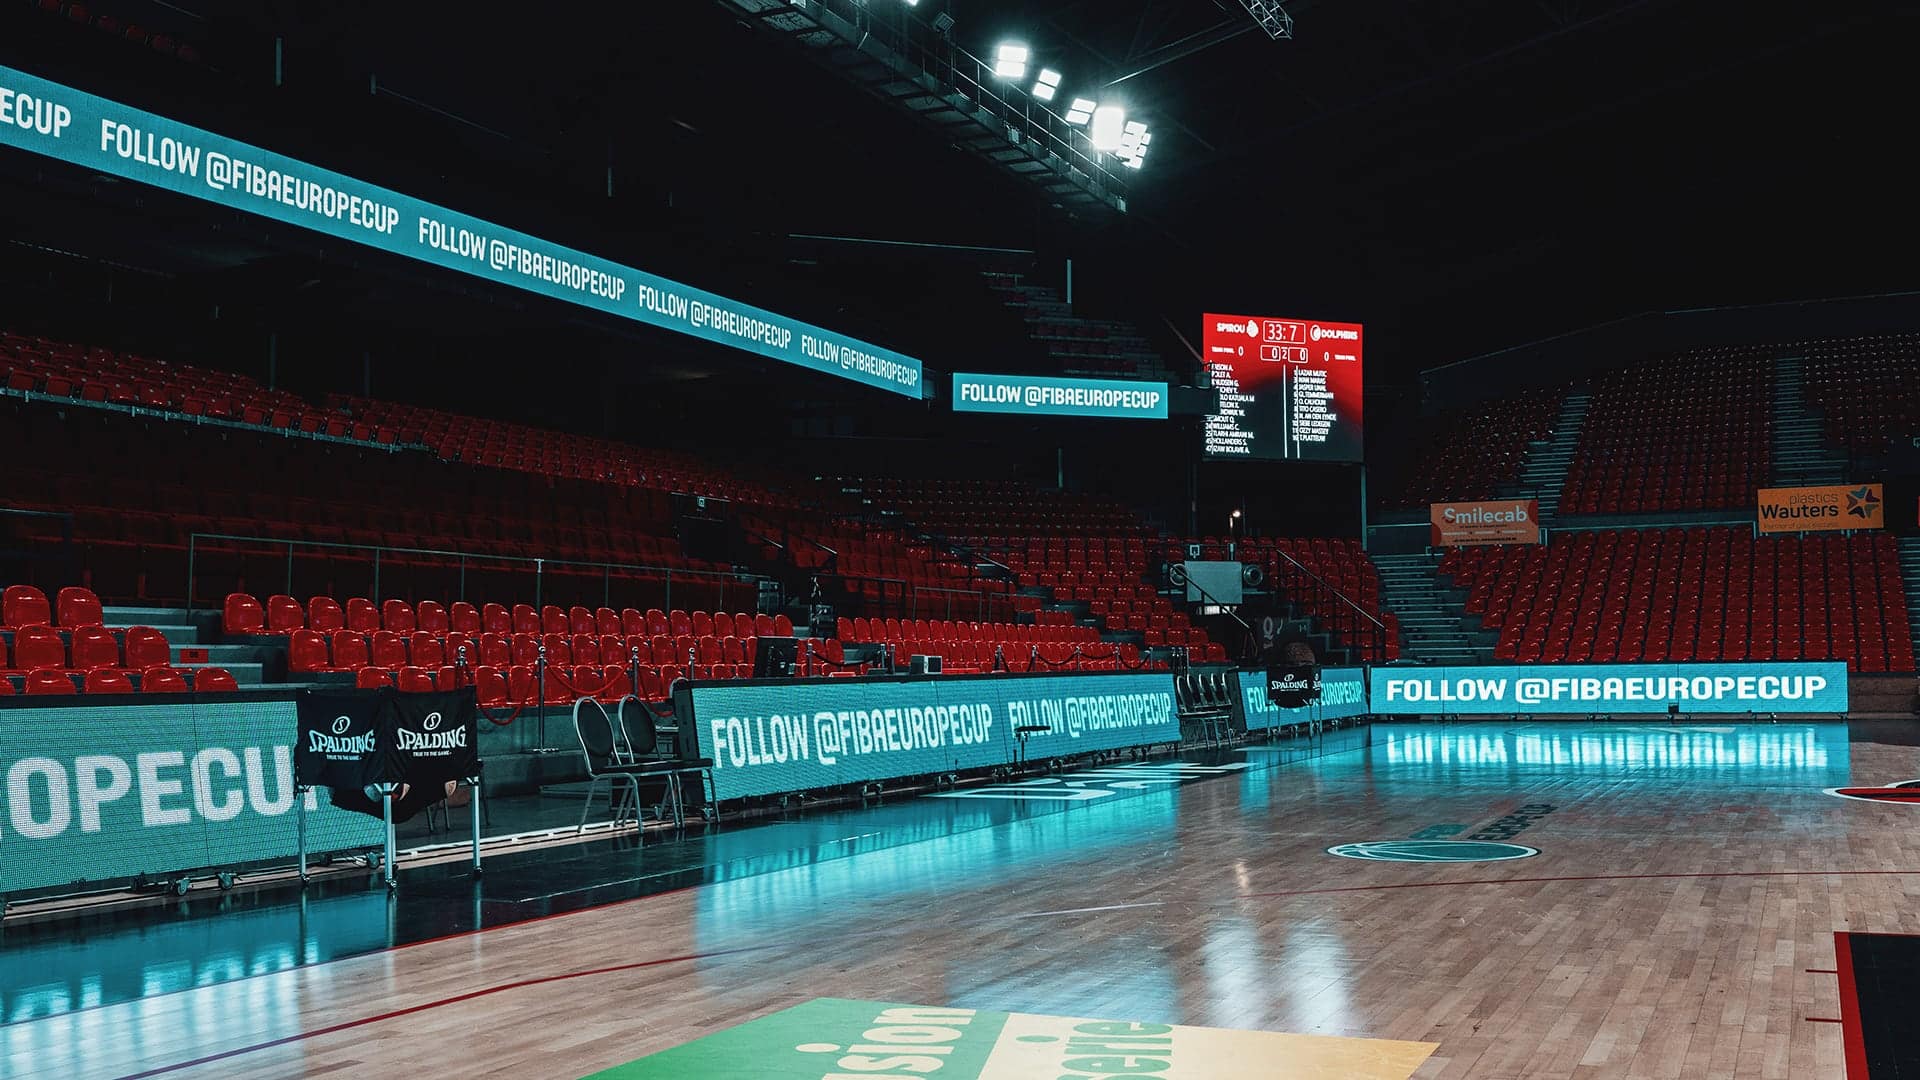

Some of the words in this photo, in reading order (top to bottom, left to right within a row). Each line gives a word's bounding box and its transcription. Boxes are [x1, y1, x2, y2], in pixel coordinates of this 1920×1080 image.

[0, 87, 71, 138] ECUP
[101, 118, 201, 177] FOLLOW
[206, 151, 399, 234] @FIBAEUROPECUP
[419, 217, 486, 261] FOLLOW
[490, 239, 625, 301] @FIBAEUROPECUP
[639, 284, 688, 320] FOLLOW
[691, 300, 792, 349] @FIBAEUROPECUP
[1216, 322, 1246, 333] SPIROU
[801, 334, 840, 363] FOLLOW
[841, 346, 918, 386] @FIBAEUROPECUP
[1271, 347, 1278, 359] 0
[1282, 349, 1288, 360] 2
[1299, 349, 1306, 361] 0
[961, 383, 1022, 403] FOLLOW
[1024, 386, 1160, 408] @FIBAEUROPECUP
[1760, 504, 1839, 519] Wauters
[1789, 493, 1839, 505] plastics
[1444, 505, 1527, 524] Smilecab
[1271, 680, 1308, 690] SPALDING
[1321, 680, 1363, 706] EUROPECUP
[1386, 679, 1507, 702] FOLLOW
[1515, 676, 1827, 704] @FIBAEUROPECUP
[1007, 699, 1065, 739] FOLLOW
[1065, 692, 1171, 738] @FIBAEUROPECUP
[309, 729, 376, 753] SPALDING
[396, 724, 467, 751] SPALDING
[710, 714, 809, 769] FOLLOW
[813, 703, 993, 765] @FIBAEUROPECUP
[0, 745, 318, 840] OPECU
[1015, 1021, 1173, 1080] erie
